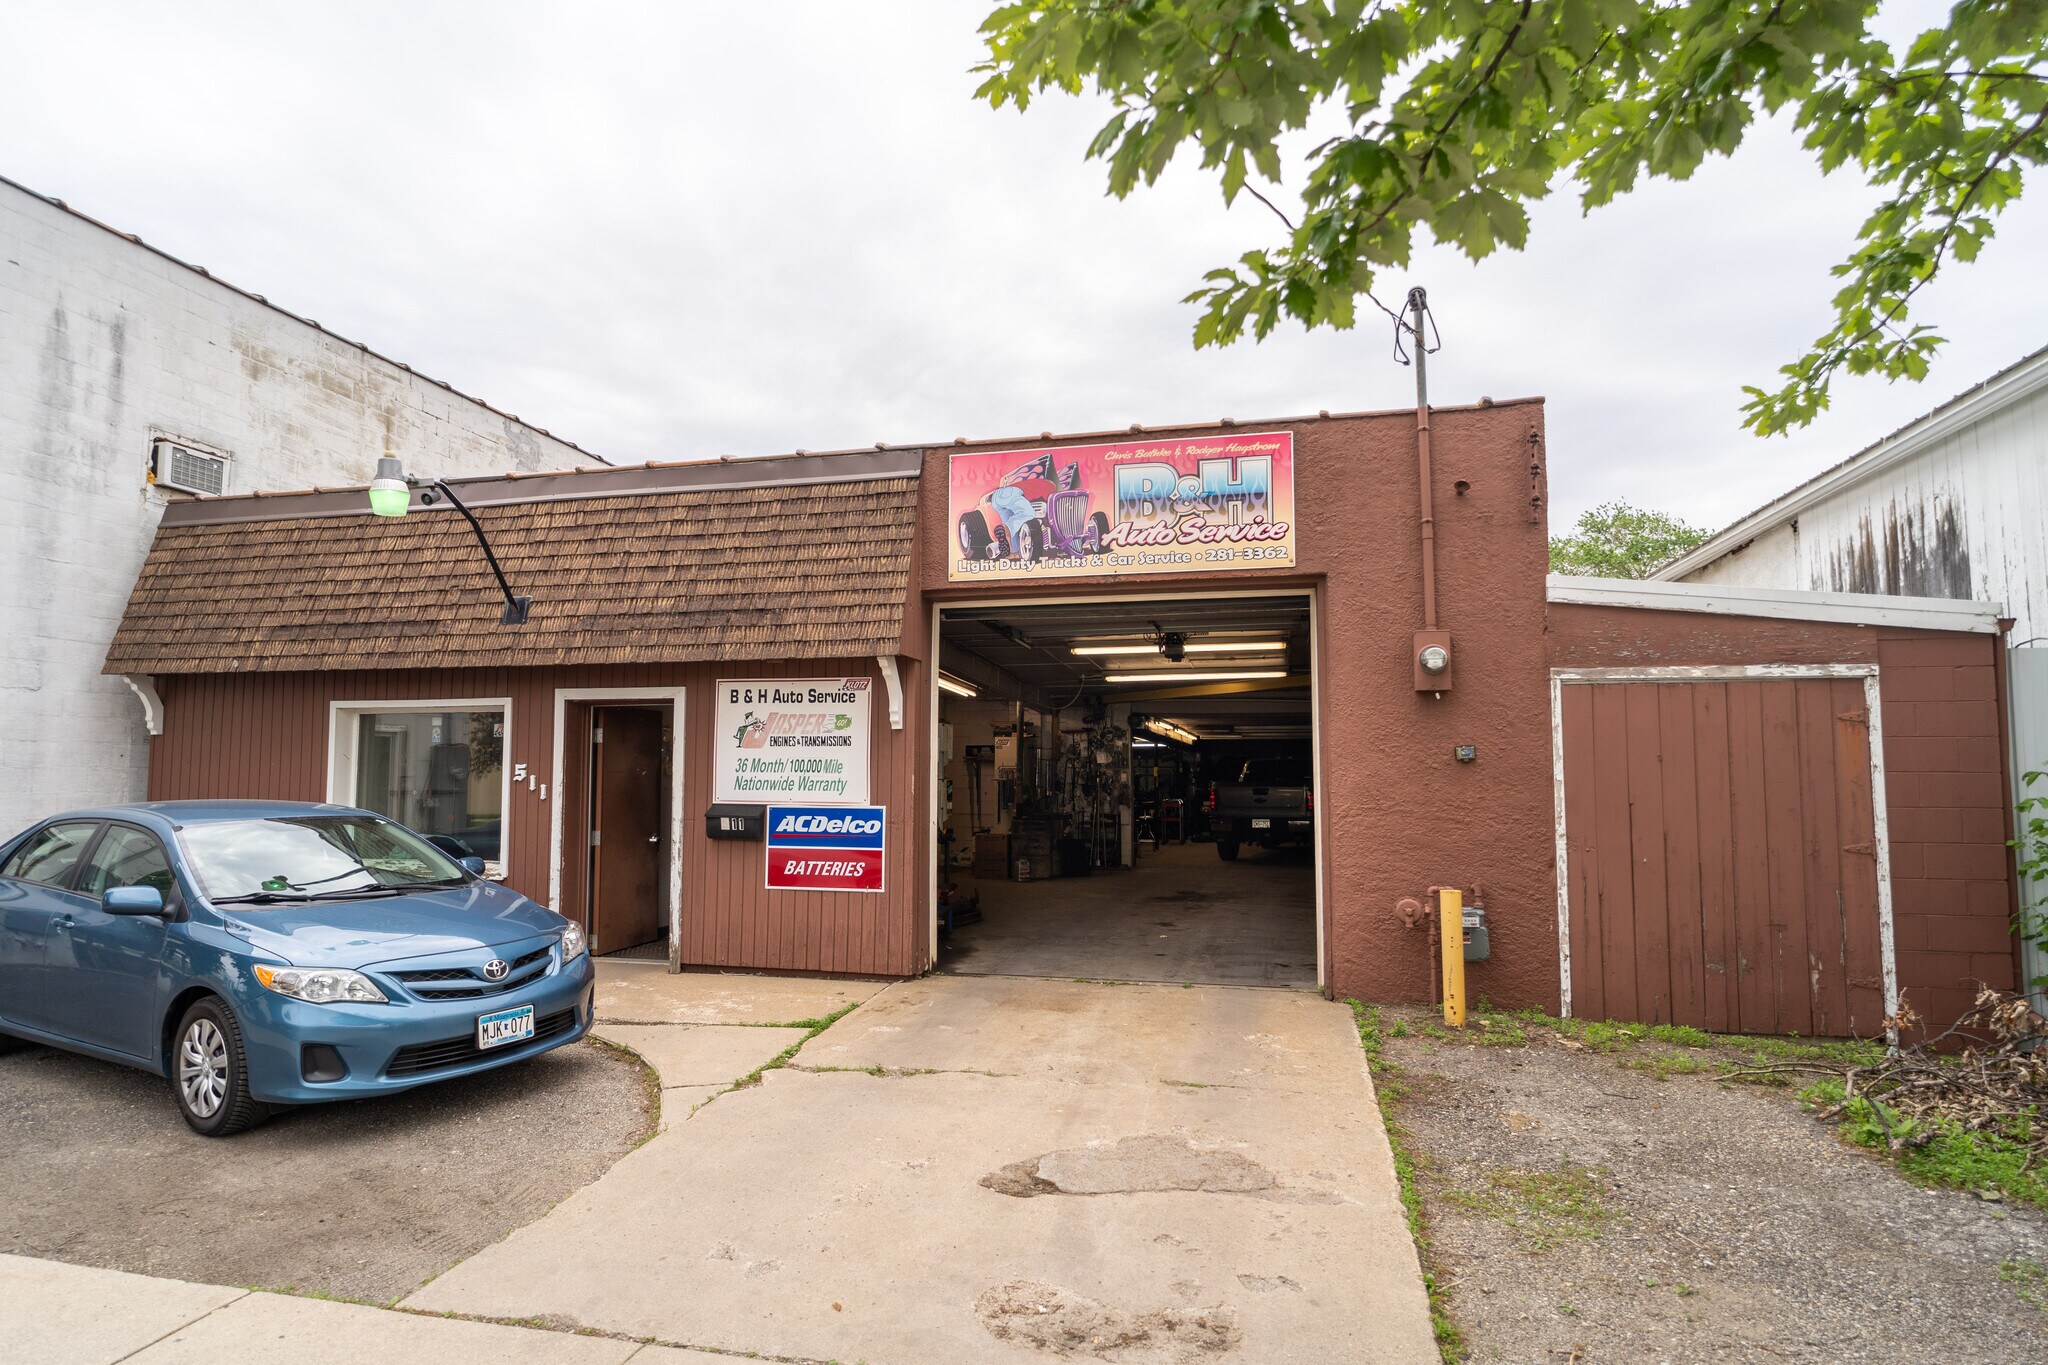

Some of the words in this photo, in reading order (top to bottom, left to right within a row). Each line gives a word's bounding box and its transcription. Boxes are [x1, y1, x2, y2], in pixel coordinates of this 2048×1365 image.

[1105, 451, 1132, 460] Chris
[1186, 445, 1223, 457] Rodger
[1226, 442, 1280, 454] Hagstrom
[1100, 520, 1177, 547] Auto
[1176, 515, 1289, 545] Service
[958, 559, 996, 573] Light
[1000, 559, 1035, 572] Duty
[1039, 556, 1087, 569] Trucks
[1090, 554, 1103, 566] &
[1107, 553, 1135, 566] Car
[1139, 551, 1191, 565] Service
[1205, 546, 1288, 562] 281-3362
[845, 681, 868, 689] KLOTZ
[730, 689, 739, 704] B
[744, 689, 753, 703] &
[758, 689, 767, 703] H
[772, 689, 803, 703] Auto
[808, 688, 856, 703] Service
[741, 712, 827, 749] JASPER
[770, 736, 796, 747] ENGINES
[801, 736, 852, 747] TRANSMISSIONS
[735, 758, 748, 773] 36
[790, 759, 822, 775] 100,000
[823, 759, 843, 774] Mile
[734, 776, 794, 791] Nationwide
[798, 776, 847, 796] Warranty
[776, 815, 881, 833] ACDelco
[784, 860, 865, 877] BATTERIES
